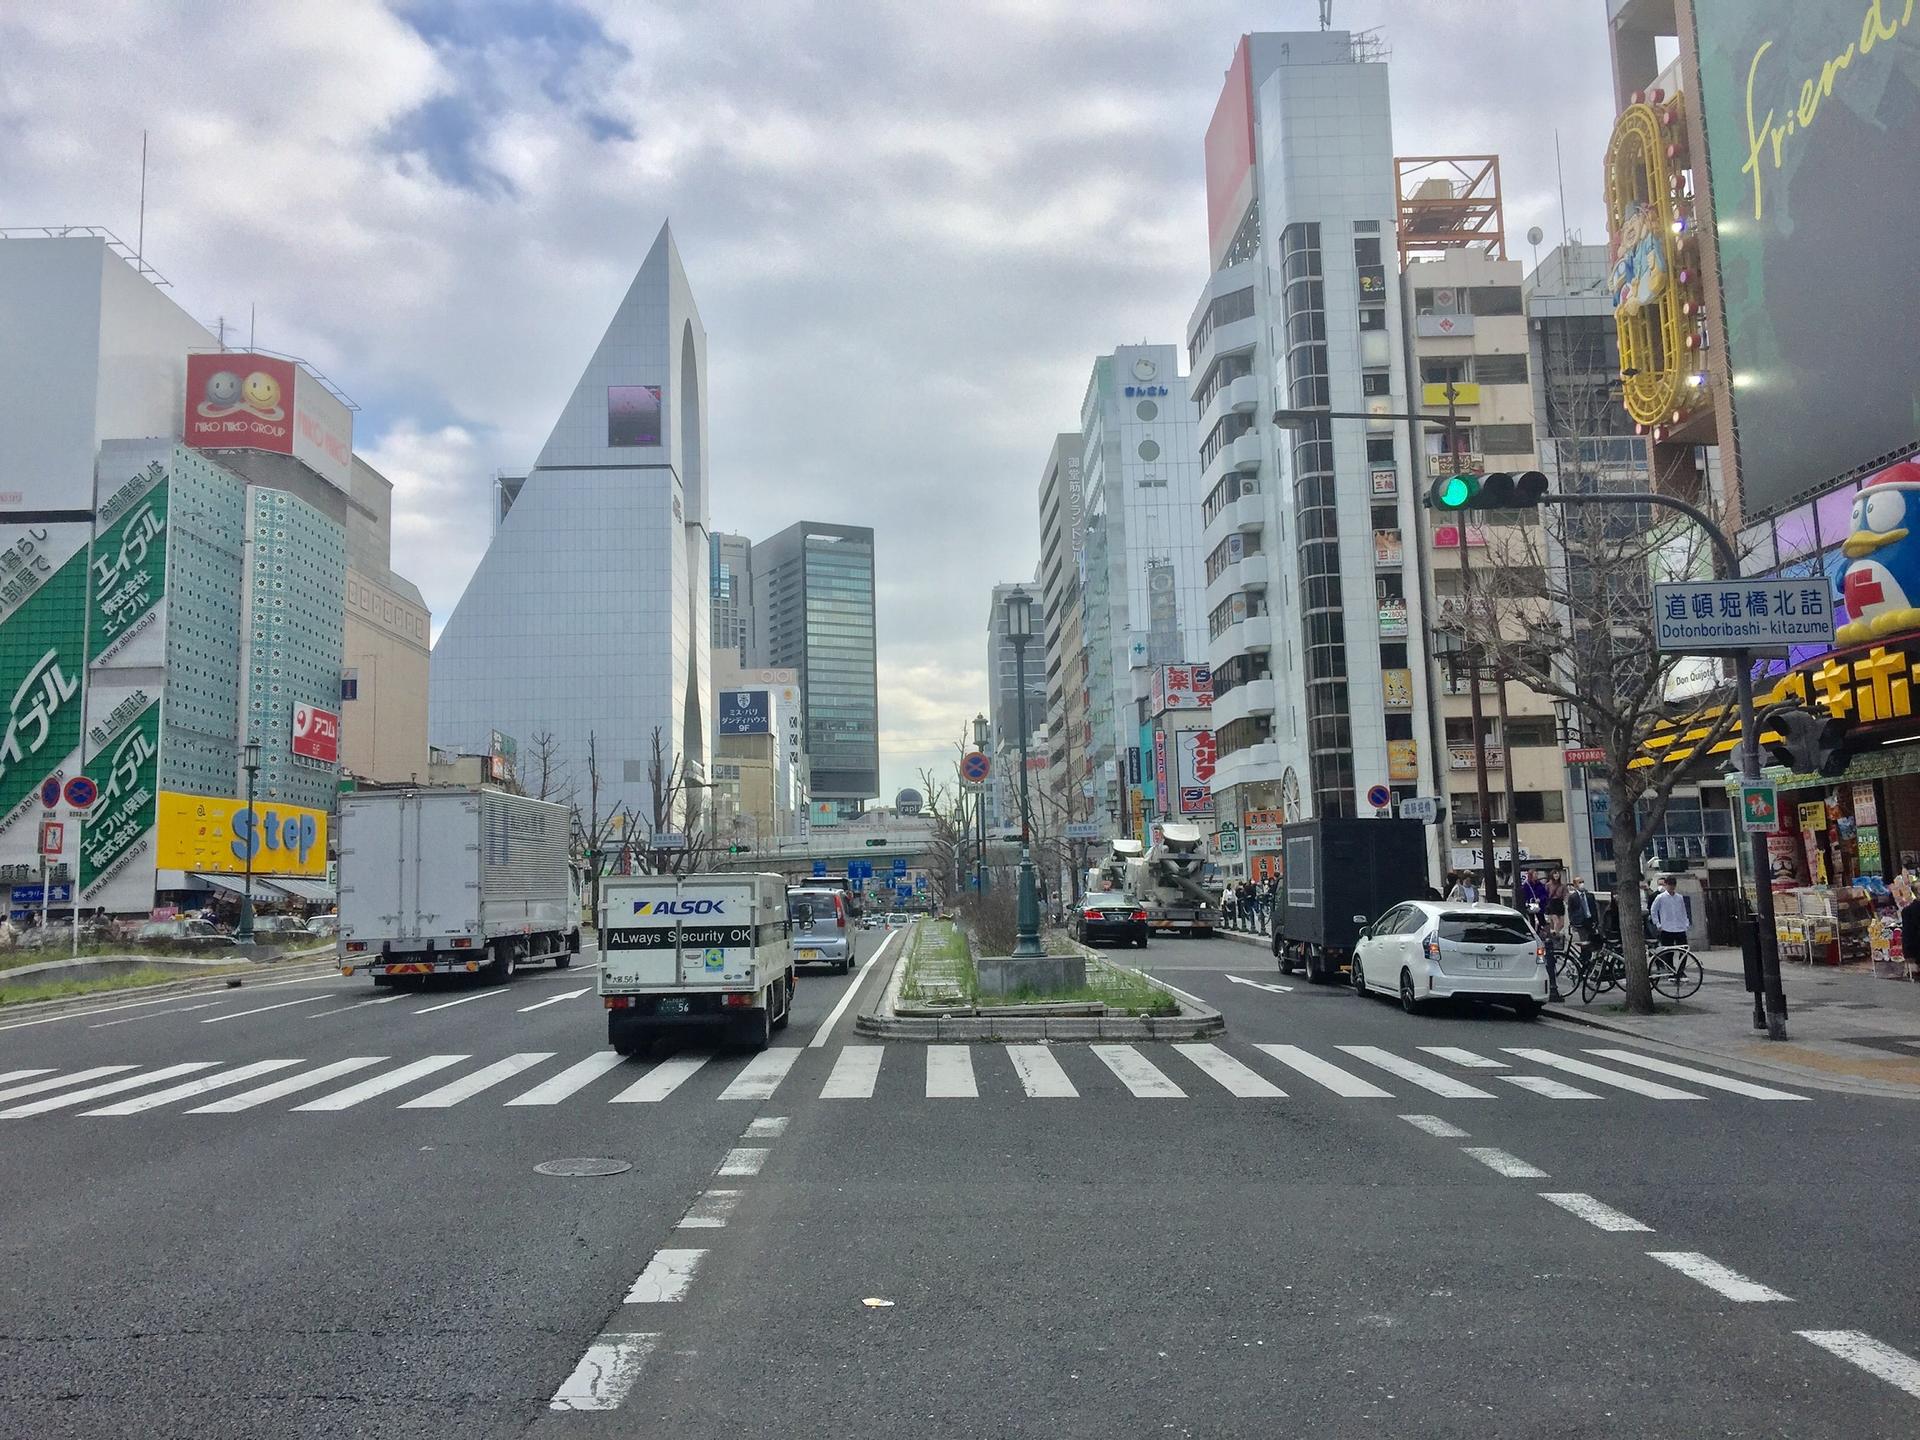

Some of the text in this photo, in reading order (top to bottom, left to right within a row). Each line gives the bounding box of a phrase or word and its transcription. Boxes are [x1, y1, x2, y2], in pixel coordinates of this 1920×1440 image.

[1742, 0, 1915, 220] Friend
[251, 423, 285, 438] GROUP
[0, 528, 48, 583] 暮らし
[92, 502, 165, 600] エイブル
[0, 554, 51, 611] 部屋で
[101, 569, 152, 616] 株式会社
[1665, 589, 1823, 620] 道頓堀橋北詰
[102, 592, 150, 637] エイブル
[1662, 620, 1829, 640] Dotonboribashi-kitazume
[98, 611, 156, 666] www.able.co.jp
[1676, 675, 1689, 685] Don
[0, 648, 78, 775] イブル
[89, 690, 148, 746] 借上保証は
[314, 717, 335, 738] アコム
[738, 724, 750, 732] 9F
[90, 820, 143, 867] 株式会社
[231, 808, 315, 864] Step
[1470, 828, 1497, 837] DUK
[1, 863, 68, 880] 賃貸・理
[653, 900, 725, 915] ALSOK
[611, 929, 750, 945] ALways Security OK
